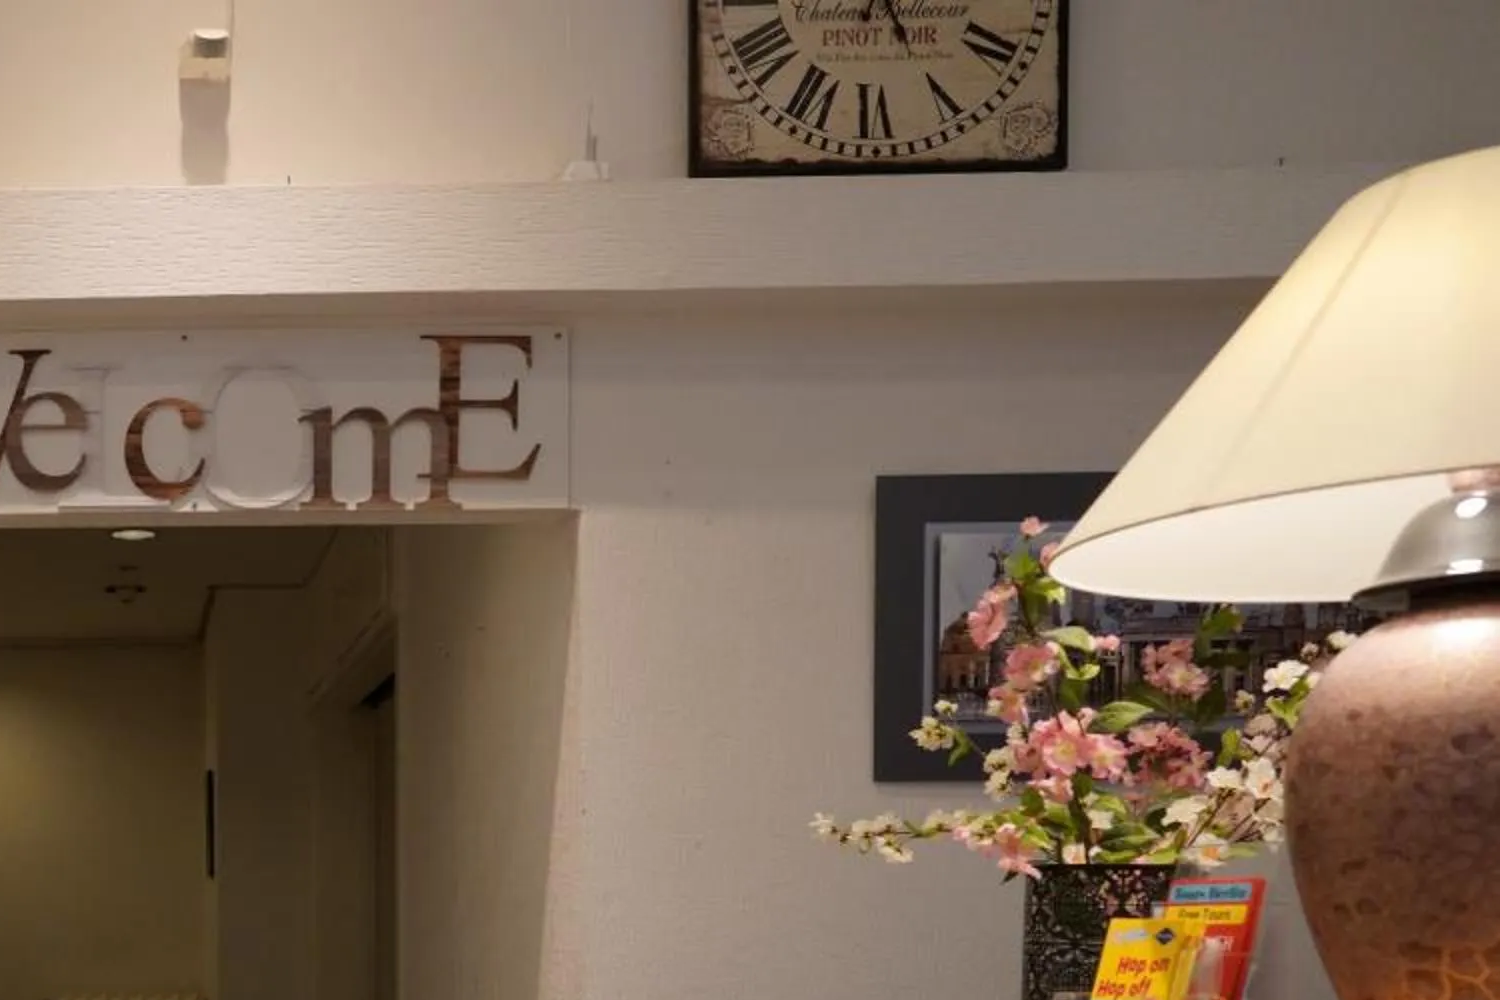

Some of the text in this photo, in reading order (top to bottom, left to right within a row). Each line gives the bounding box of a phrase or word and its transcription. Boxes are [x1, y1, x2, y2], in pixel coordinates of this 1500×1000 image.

[822, 28, 884, 47] PINOT
[1116, 957, 1148, 977] Hop
[1097, 975, 1153, 1000] Hop off
